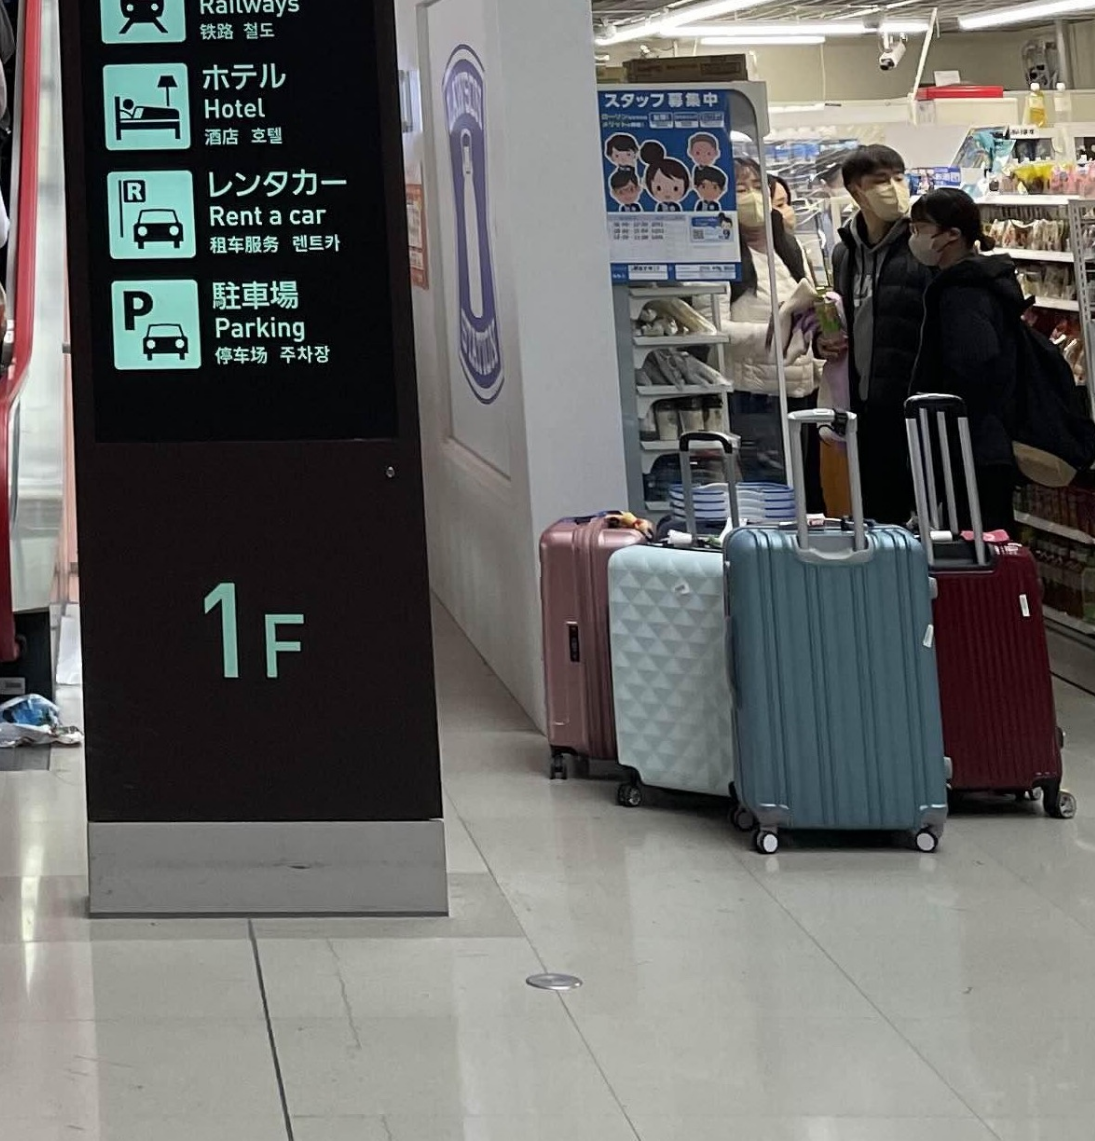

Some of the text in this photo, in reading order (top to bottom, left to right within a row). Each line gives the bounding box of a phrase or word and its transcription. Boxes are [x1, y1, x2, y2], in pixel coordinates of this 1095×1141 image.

[199, 23, 234, 40] 铁路
[243, 22, 275, 39] 철도
[202, 63, 287, 91] ホテル
[204, 98, 266, 119] Hotel
[204, 129, 239, 145] 酒店
[251, 127, 283, 144] 호텔
[126, 182, 143, 202] R
[208, 169, 347, 198] レンタカー
[209, 206, 327, 227] Rent a car
[209, 236, 279, 253] 租车服务
[292, 234, 341, 252] 렌트카
[212, 281, 299, 310] 駐車場
[123, 290, 153, 331] P
[215, 317, 305, 342] Parking
[215, 346, 268, 365] 停车场
[280, 345, 330, 364] 주차장
[204, 582, 304, 679] 1F
